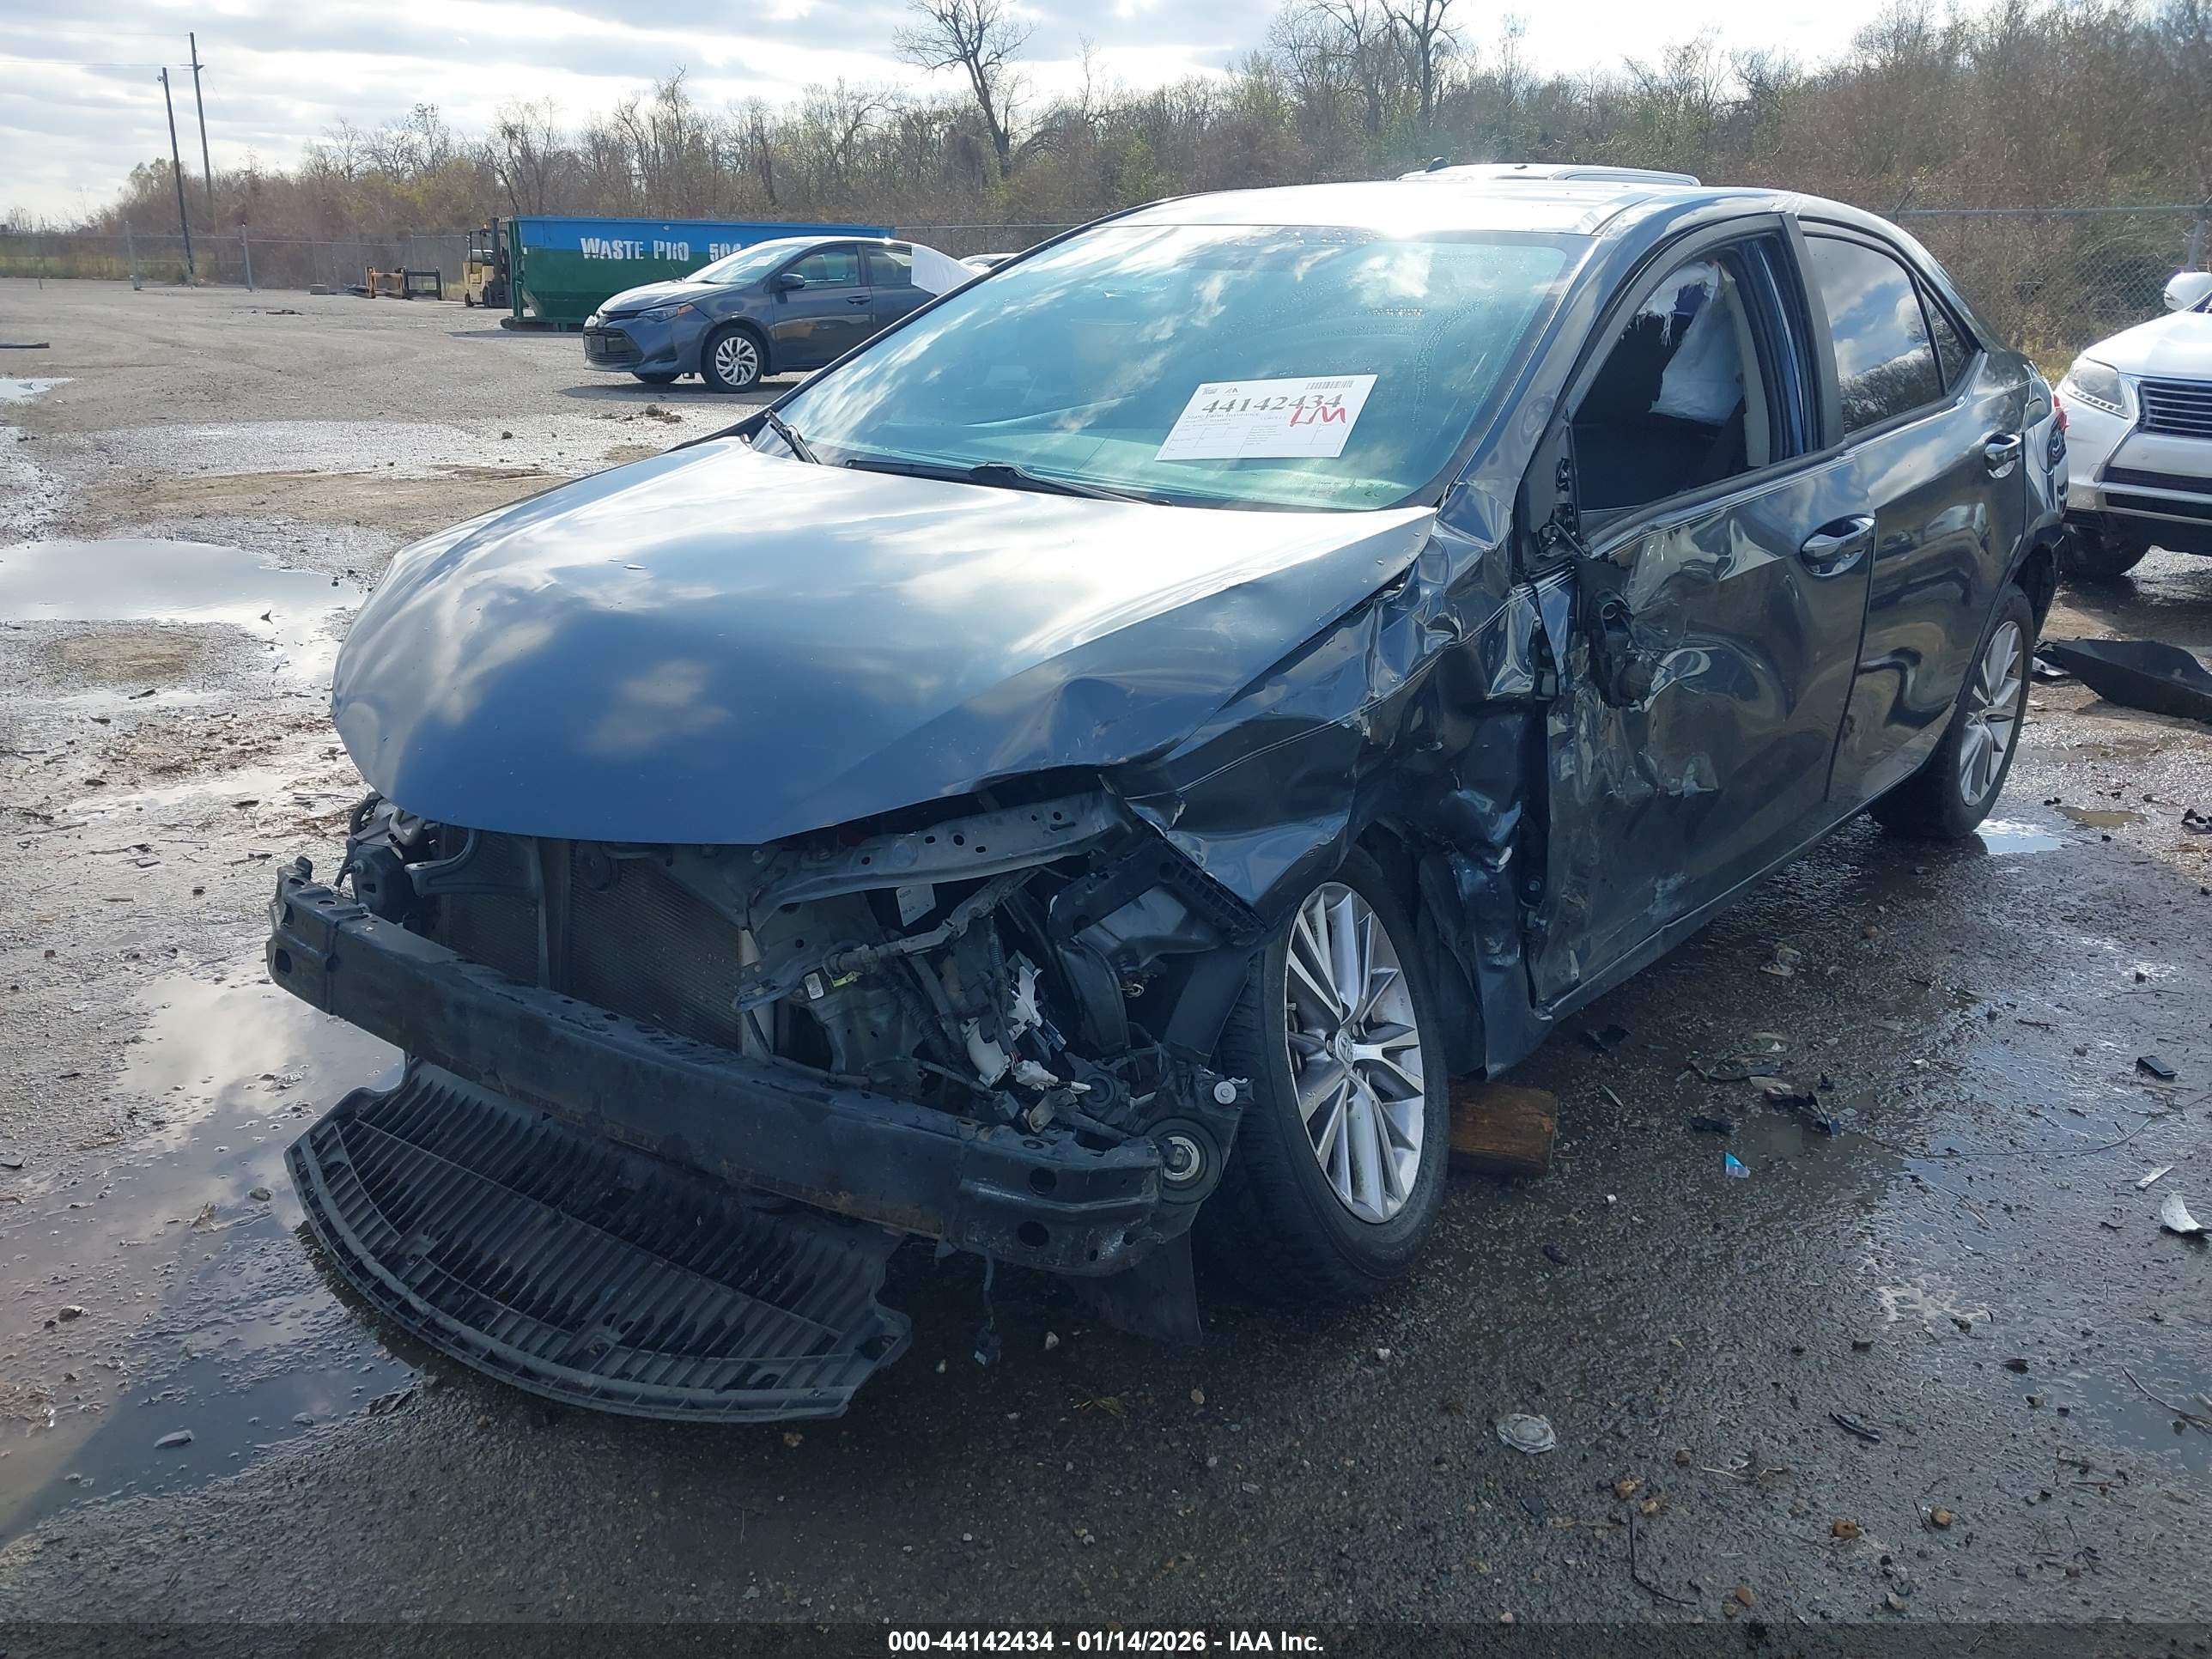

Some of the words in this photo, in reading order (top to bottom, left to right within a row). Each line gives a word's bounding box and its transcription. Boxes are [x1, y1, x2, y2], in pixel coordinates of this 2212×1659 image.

[580, 237, 644, 260] WASTE
[653, 240, 690, 262] PRO
[1201, 393, 1343, 413] 44142434
